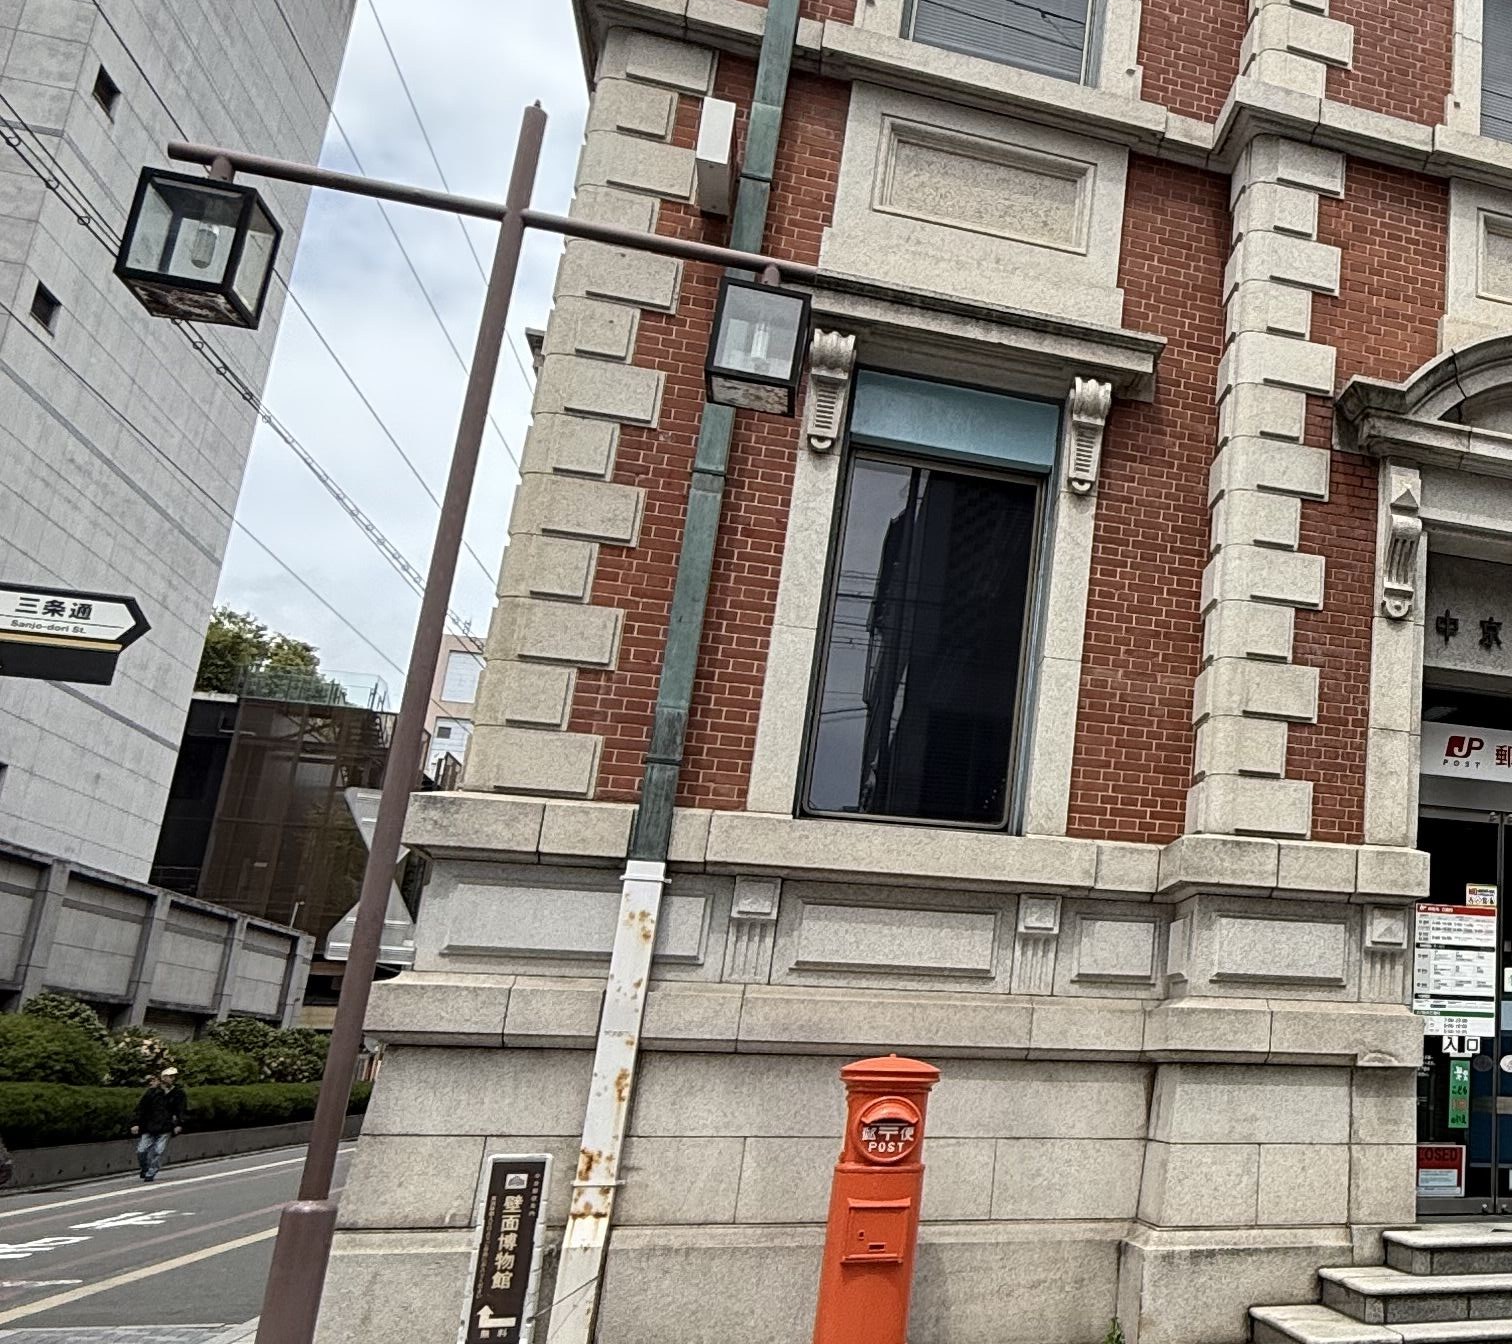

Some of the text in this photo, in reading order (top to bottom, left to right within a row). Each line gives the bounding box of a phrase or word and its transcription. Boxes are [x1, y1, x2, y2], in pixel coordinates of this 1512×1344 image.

[15, 597, 93, 620] 三条通
[11, 619, 87, 634] Sanjo-dori St.
[1442, 759, 1481, 769] POST
[1443, 1036, 1479, 1052] 入口
[868, 1141, 905, 1153] POST
[1417, 1147, 1457, 1161] LOSED
[491, 1194, 523, 1289] 壁面博物館
